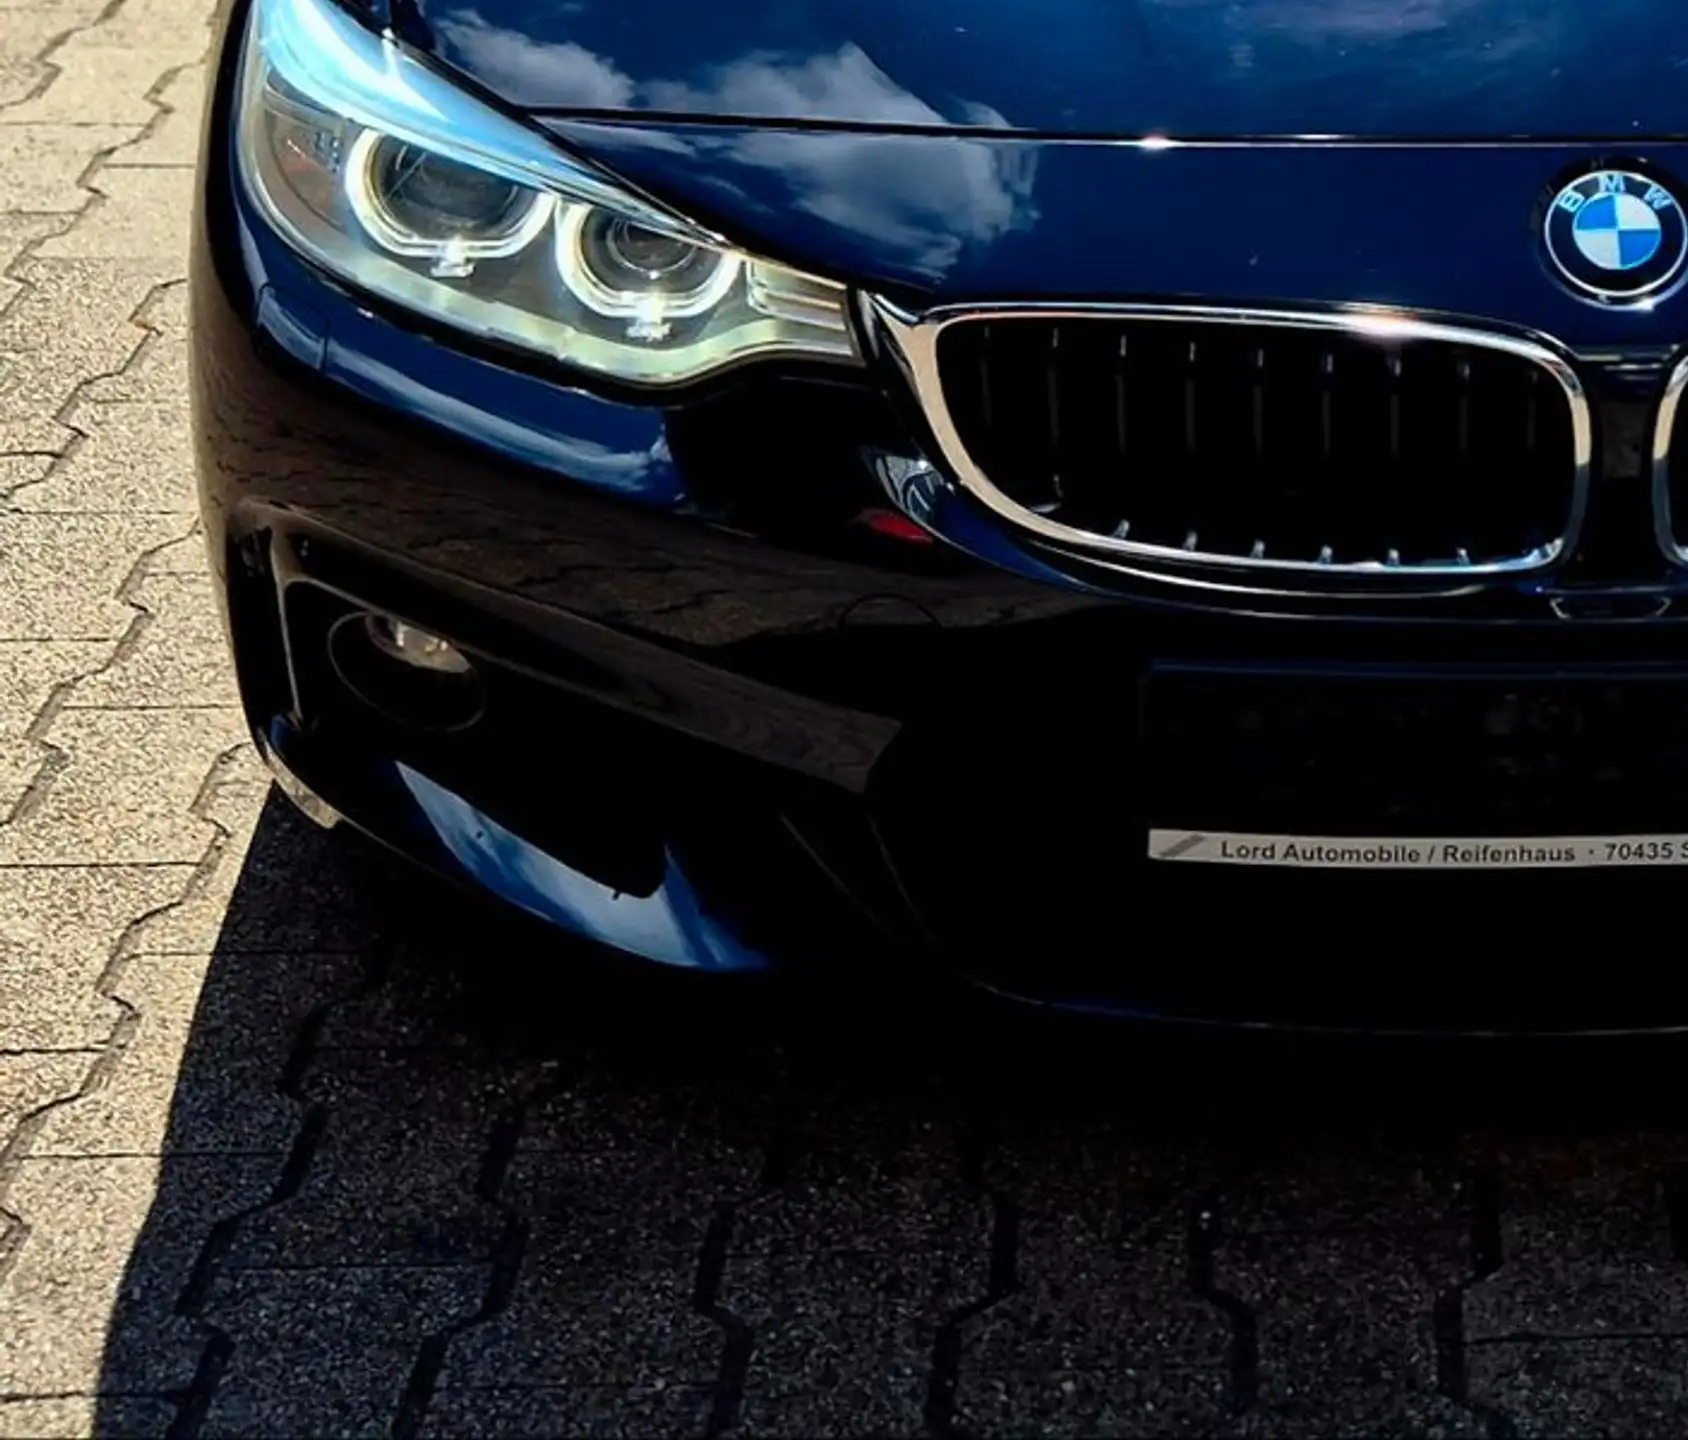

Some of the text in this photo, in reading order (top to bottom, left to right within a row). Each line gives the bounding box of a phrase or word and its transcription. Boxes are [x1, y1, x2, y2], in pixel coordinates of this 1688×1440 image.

[1557, 172, 1673, 213] BMW
[1220, 840, 1276, 860] Lord
[1282, 843, 1421, 863] Automobile
[1441, 844, 1576, 864] Reifenhaus
[1603, 841, 1674, 861] 70435
